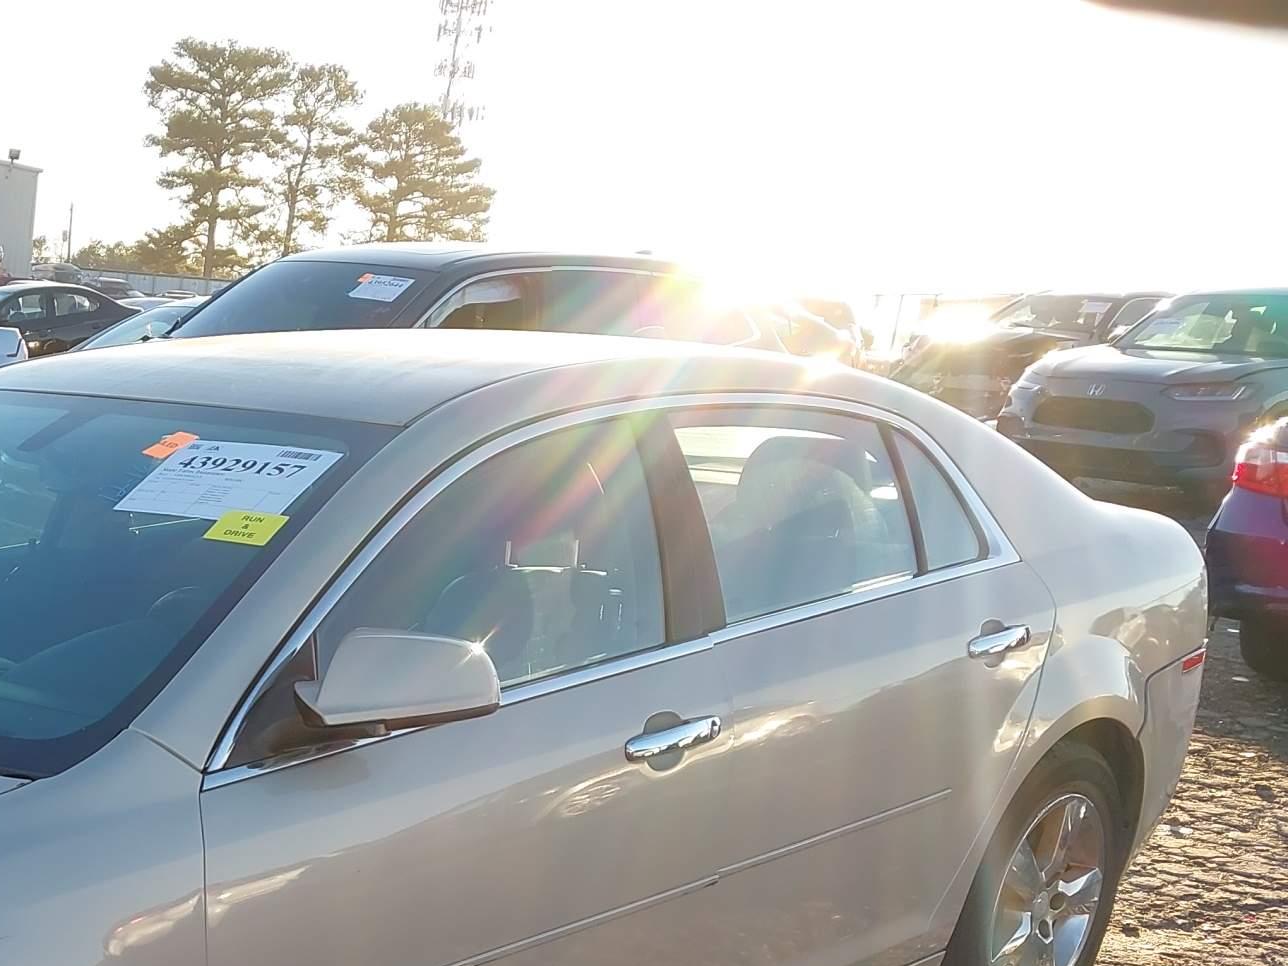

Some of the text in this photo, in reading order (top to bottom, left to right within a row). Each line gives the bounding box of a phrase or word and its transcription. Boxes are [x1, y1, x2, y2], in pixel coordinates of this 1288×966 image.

[178, 455, 307, 479] 43929157
[241, 515, 265, 523] RUN
[223, 529, 256, 539] DRIVE
